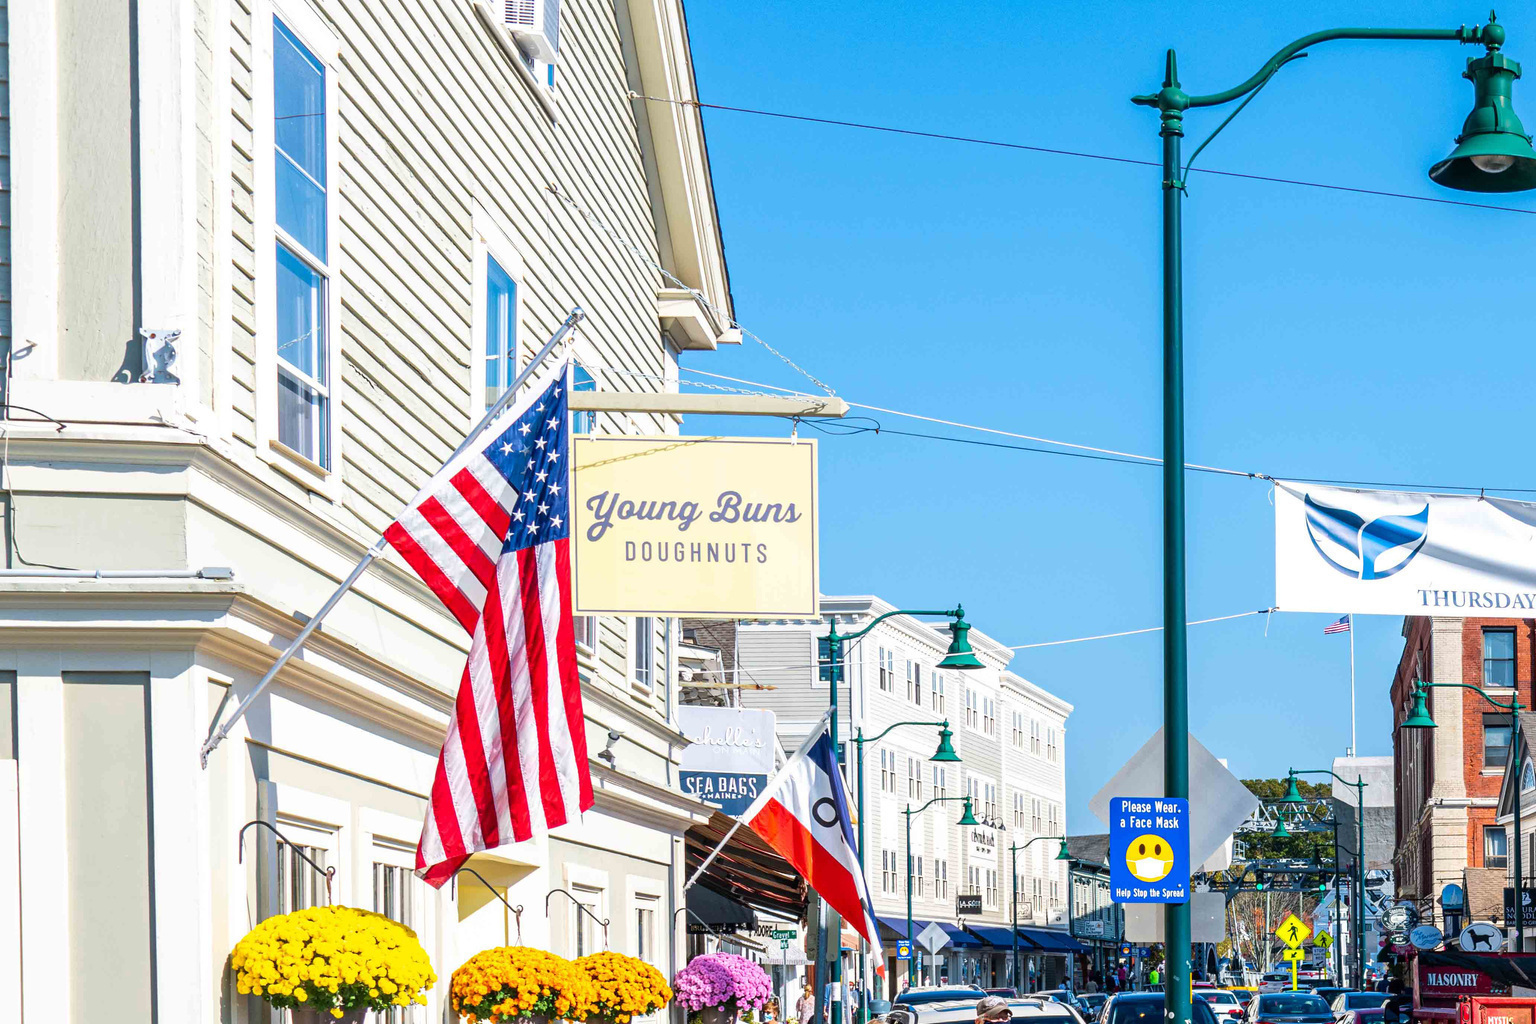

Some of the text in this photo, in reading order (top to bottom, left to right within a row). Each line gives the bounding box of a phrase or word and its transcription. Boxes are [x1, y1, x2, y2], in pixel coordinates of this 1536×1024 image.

[586, 490, 802, 543] Young Buns
[625, 541, 768, 564] DOUGHNUTS
[686, 777, 757, 798] SEA BAGS
[1122, 801, 1151, 813] Please
[1120, 816, 1179, 828] a Face Mask
[1116, 888, 1184, 899] Help Stop the Spread
[1427, 973, 1479, 986] MASONRY
